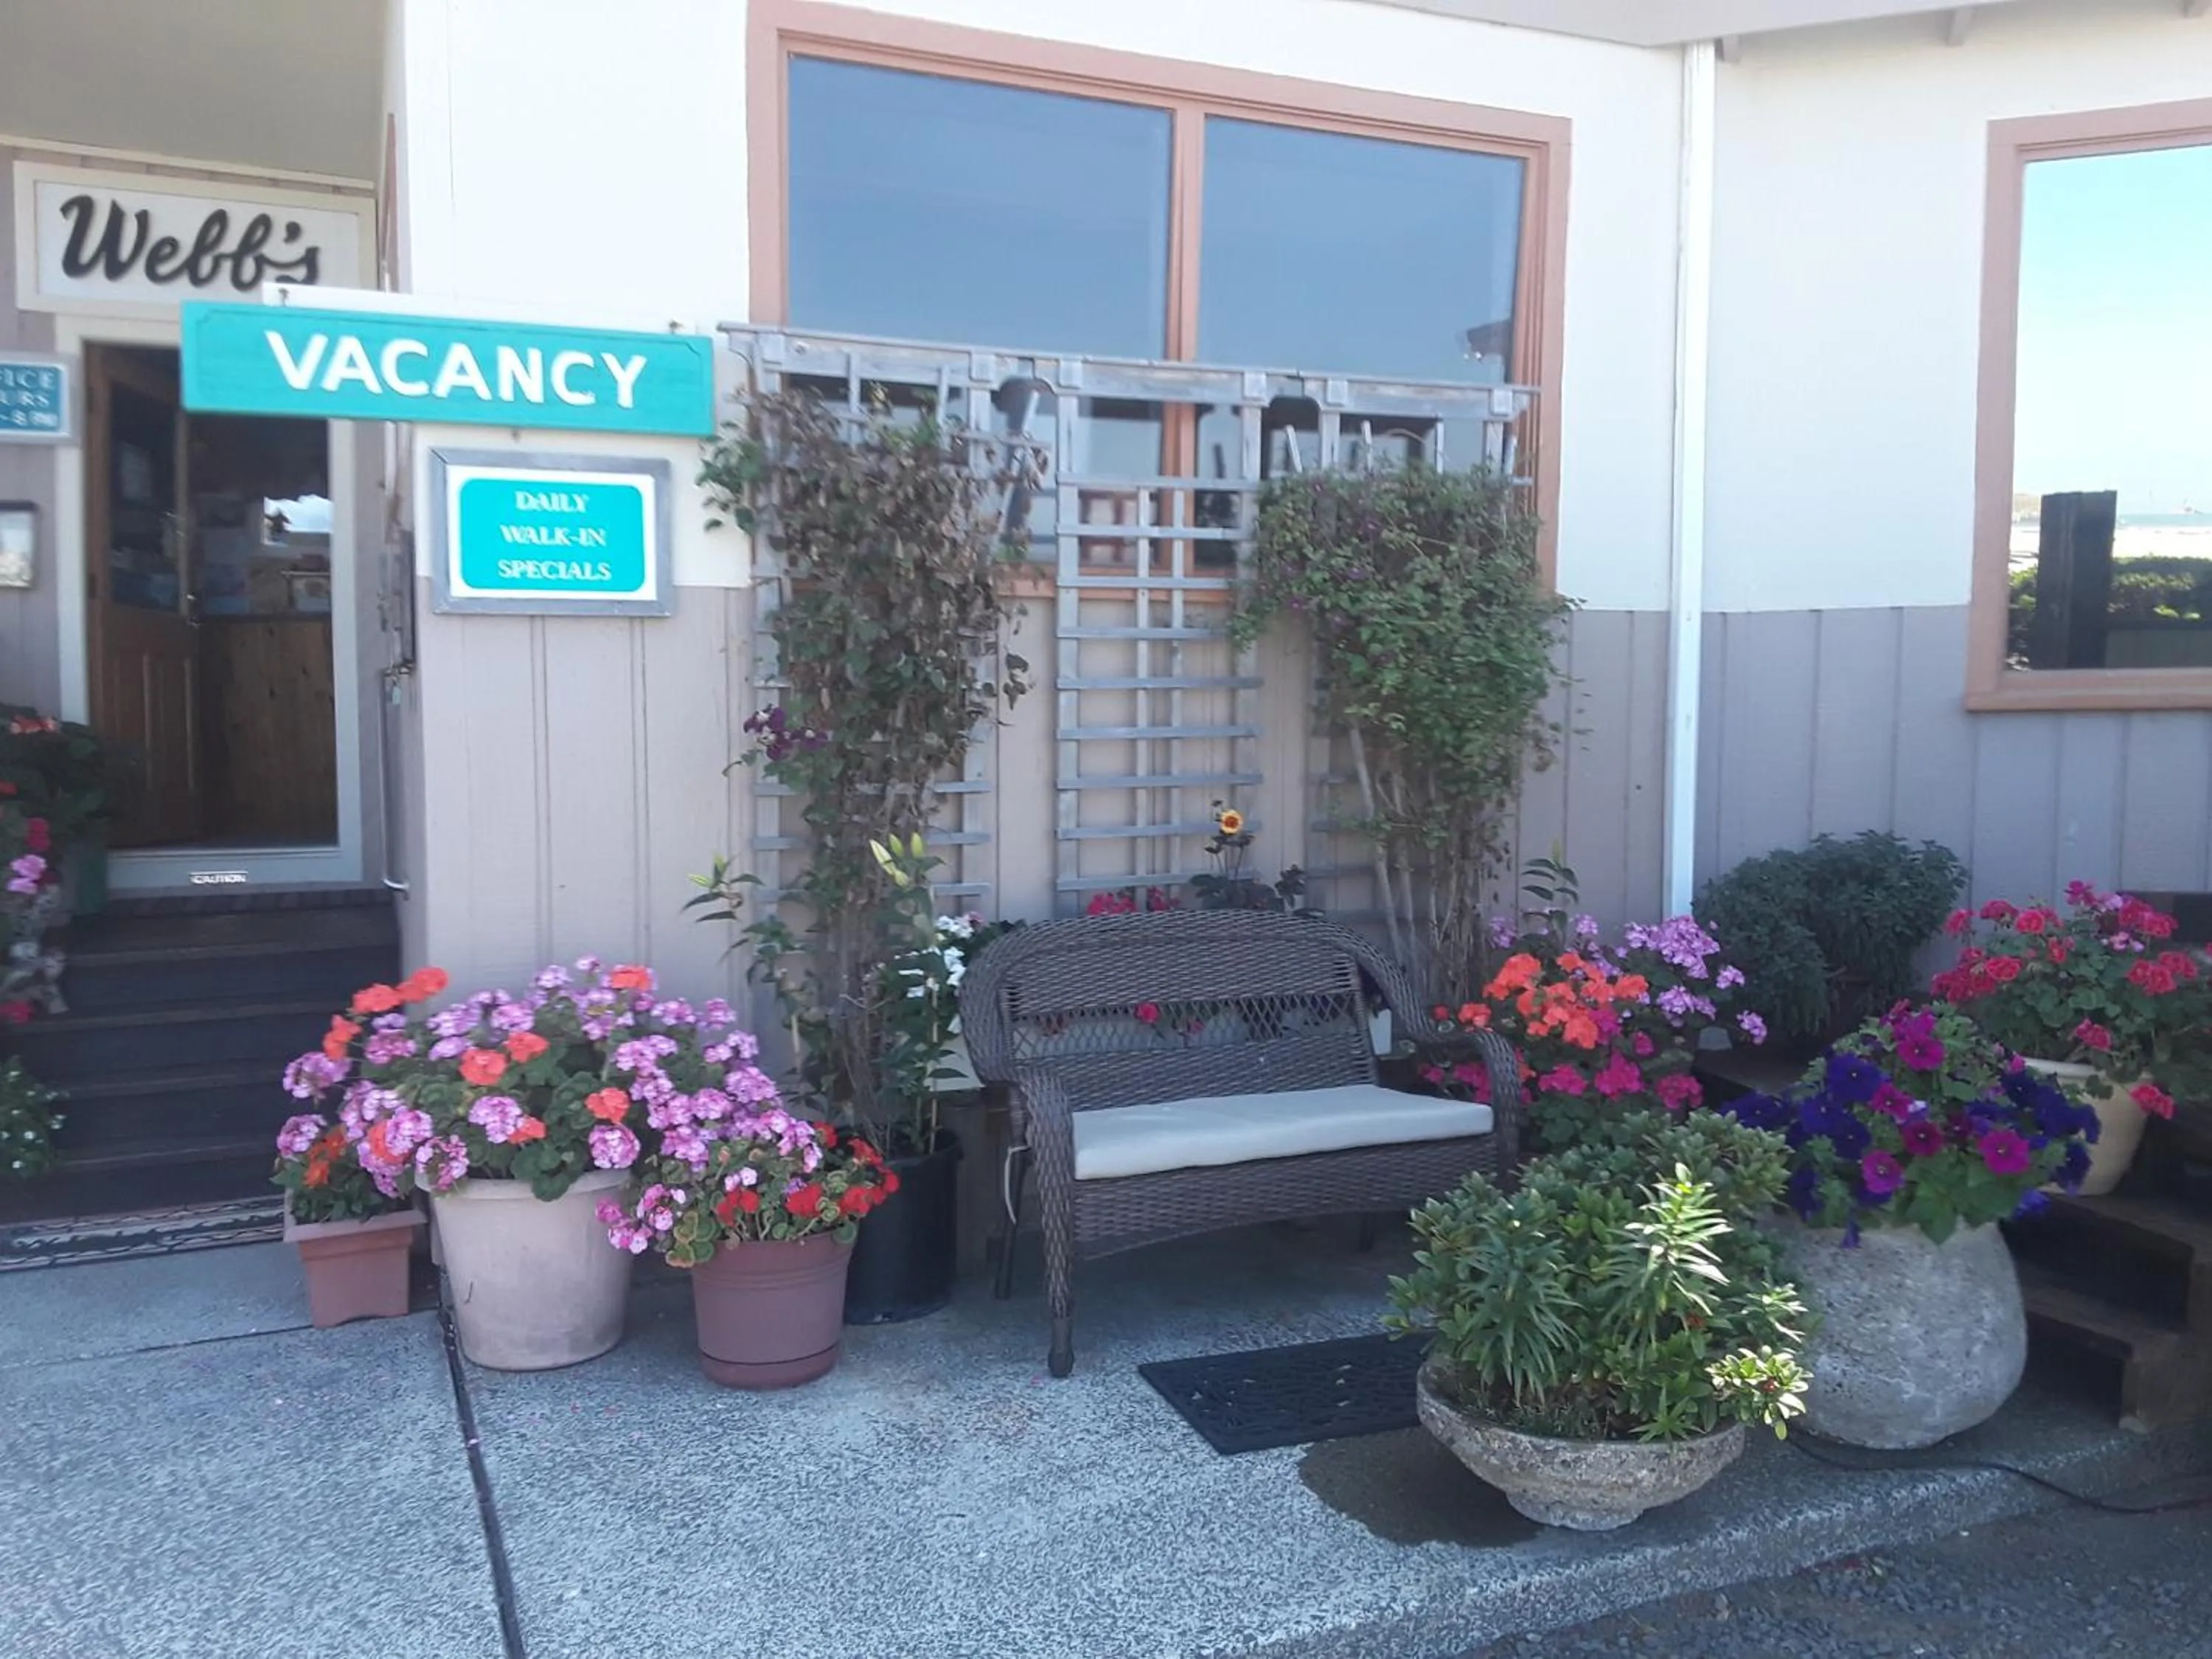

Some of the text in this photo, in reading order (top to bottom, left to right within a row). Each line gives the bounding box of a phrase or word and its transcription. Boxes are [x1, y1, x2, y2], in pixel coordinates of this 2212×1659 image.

[59, 194, 321, 292] Webb's
[265, 330, 647, 409] VACANCY
[515, 490, 589, 512] DAILY
[499, 525, 607, 546] WALK-IN
[498, 559, 612, 581] SPECIALS
[191, 874, 247, 884] CAUTION
